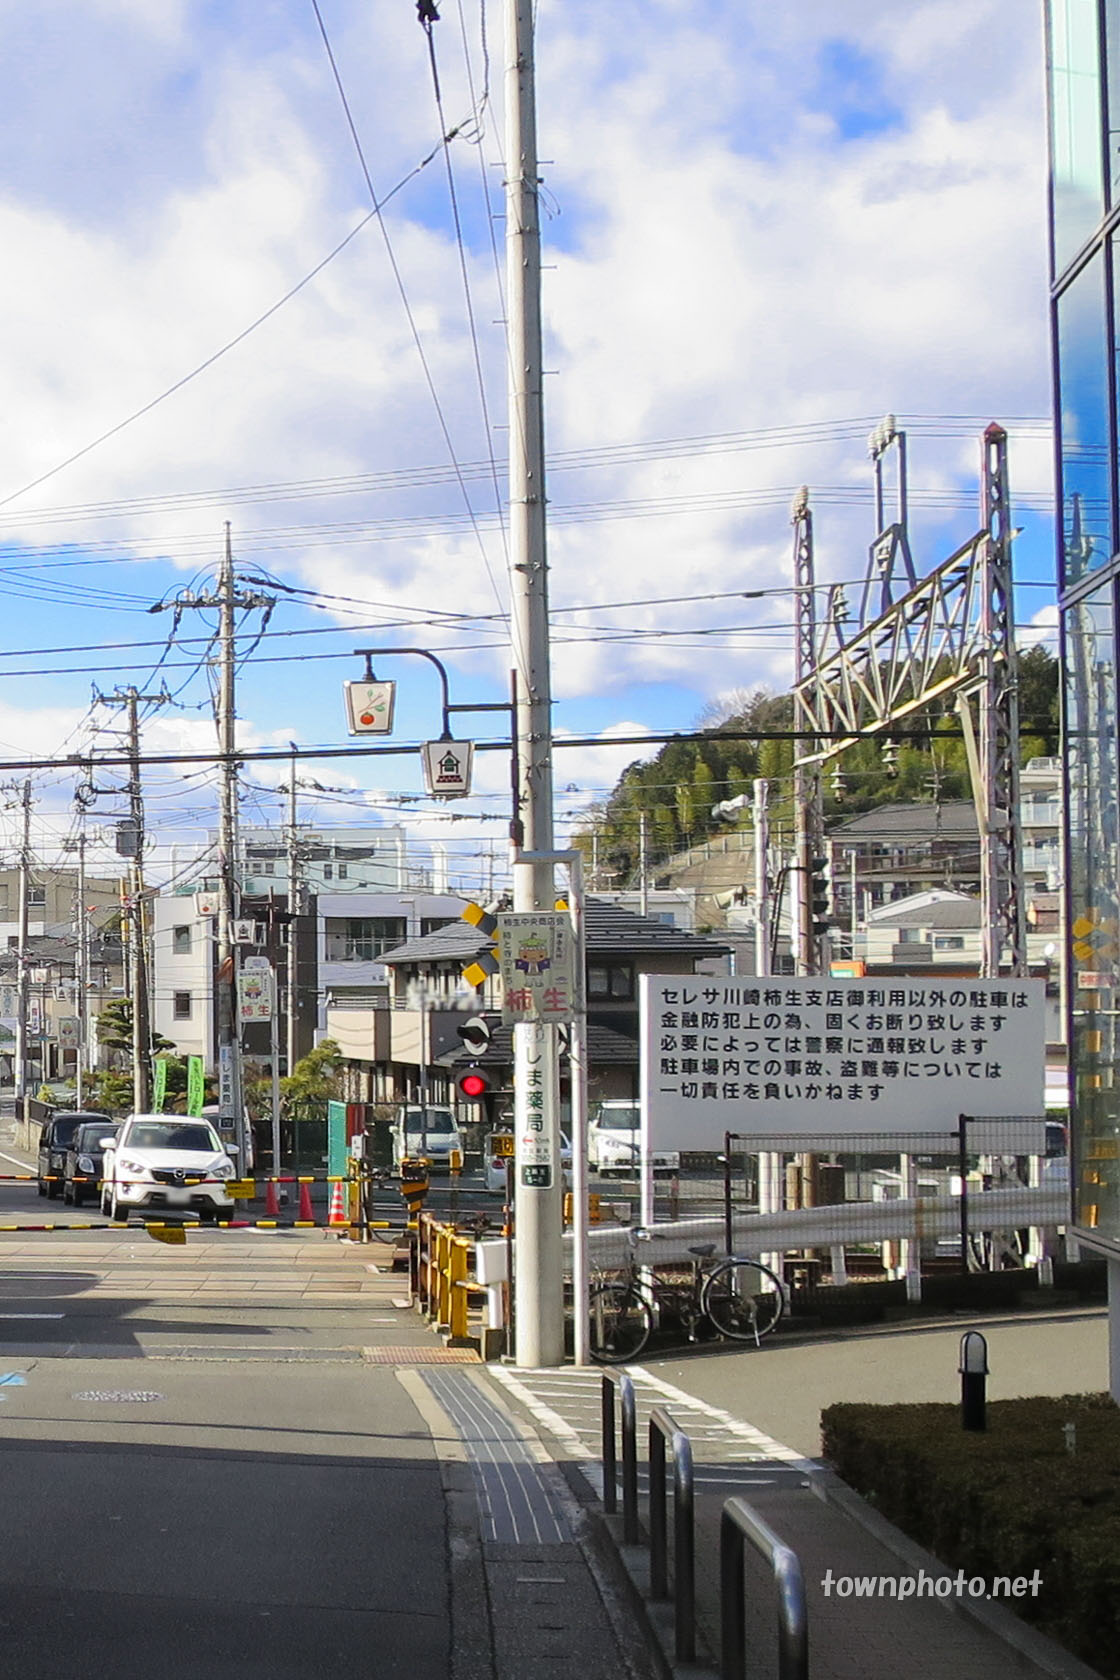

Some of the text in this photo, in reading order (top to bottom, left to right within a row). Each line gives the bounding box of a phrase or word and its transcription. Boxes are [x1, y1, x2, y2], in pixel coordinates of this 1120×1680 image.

[506, 987, 568, 1013] 柿生
[661, 988, 1029, 1008] セレサ川崎柿生支店御利用以外の駐車は
[661, 1012, 1008, 1031] 金融防犯上の為、固くお断り致します
[660, 1035, 988, 1054] 必要によっては警察に通報致します
[661, 1059, 1002, 1078] 駐車場内での事故、盗難等については
[526, 1047, 544, 1133] しま薬局
[660, 1083, 885, 1101] 一切責任を負いかねます
